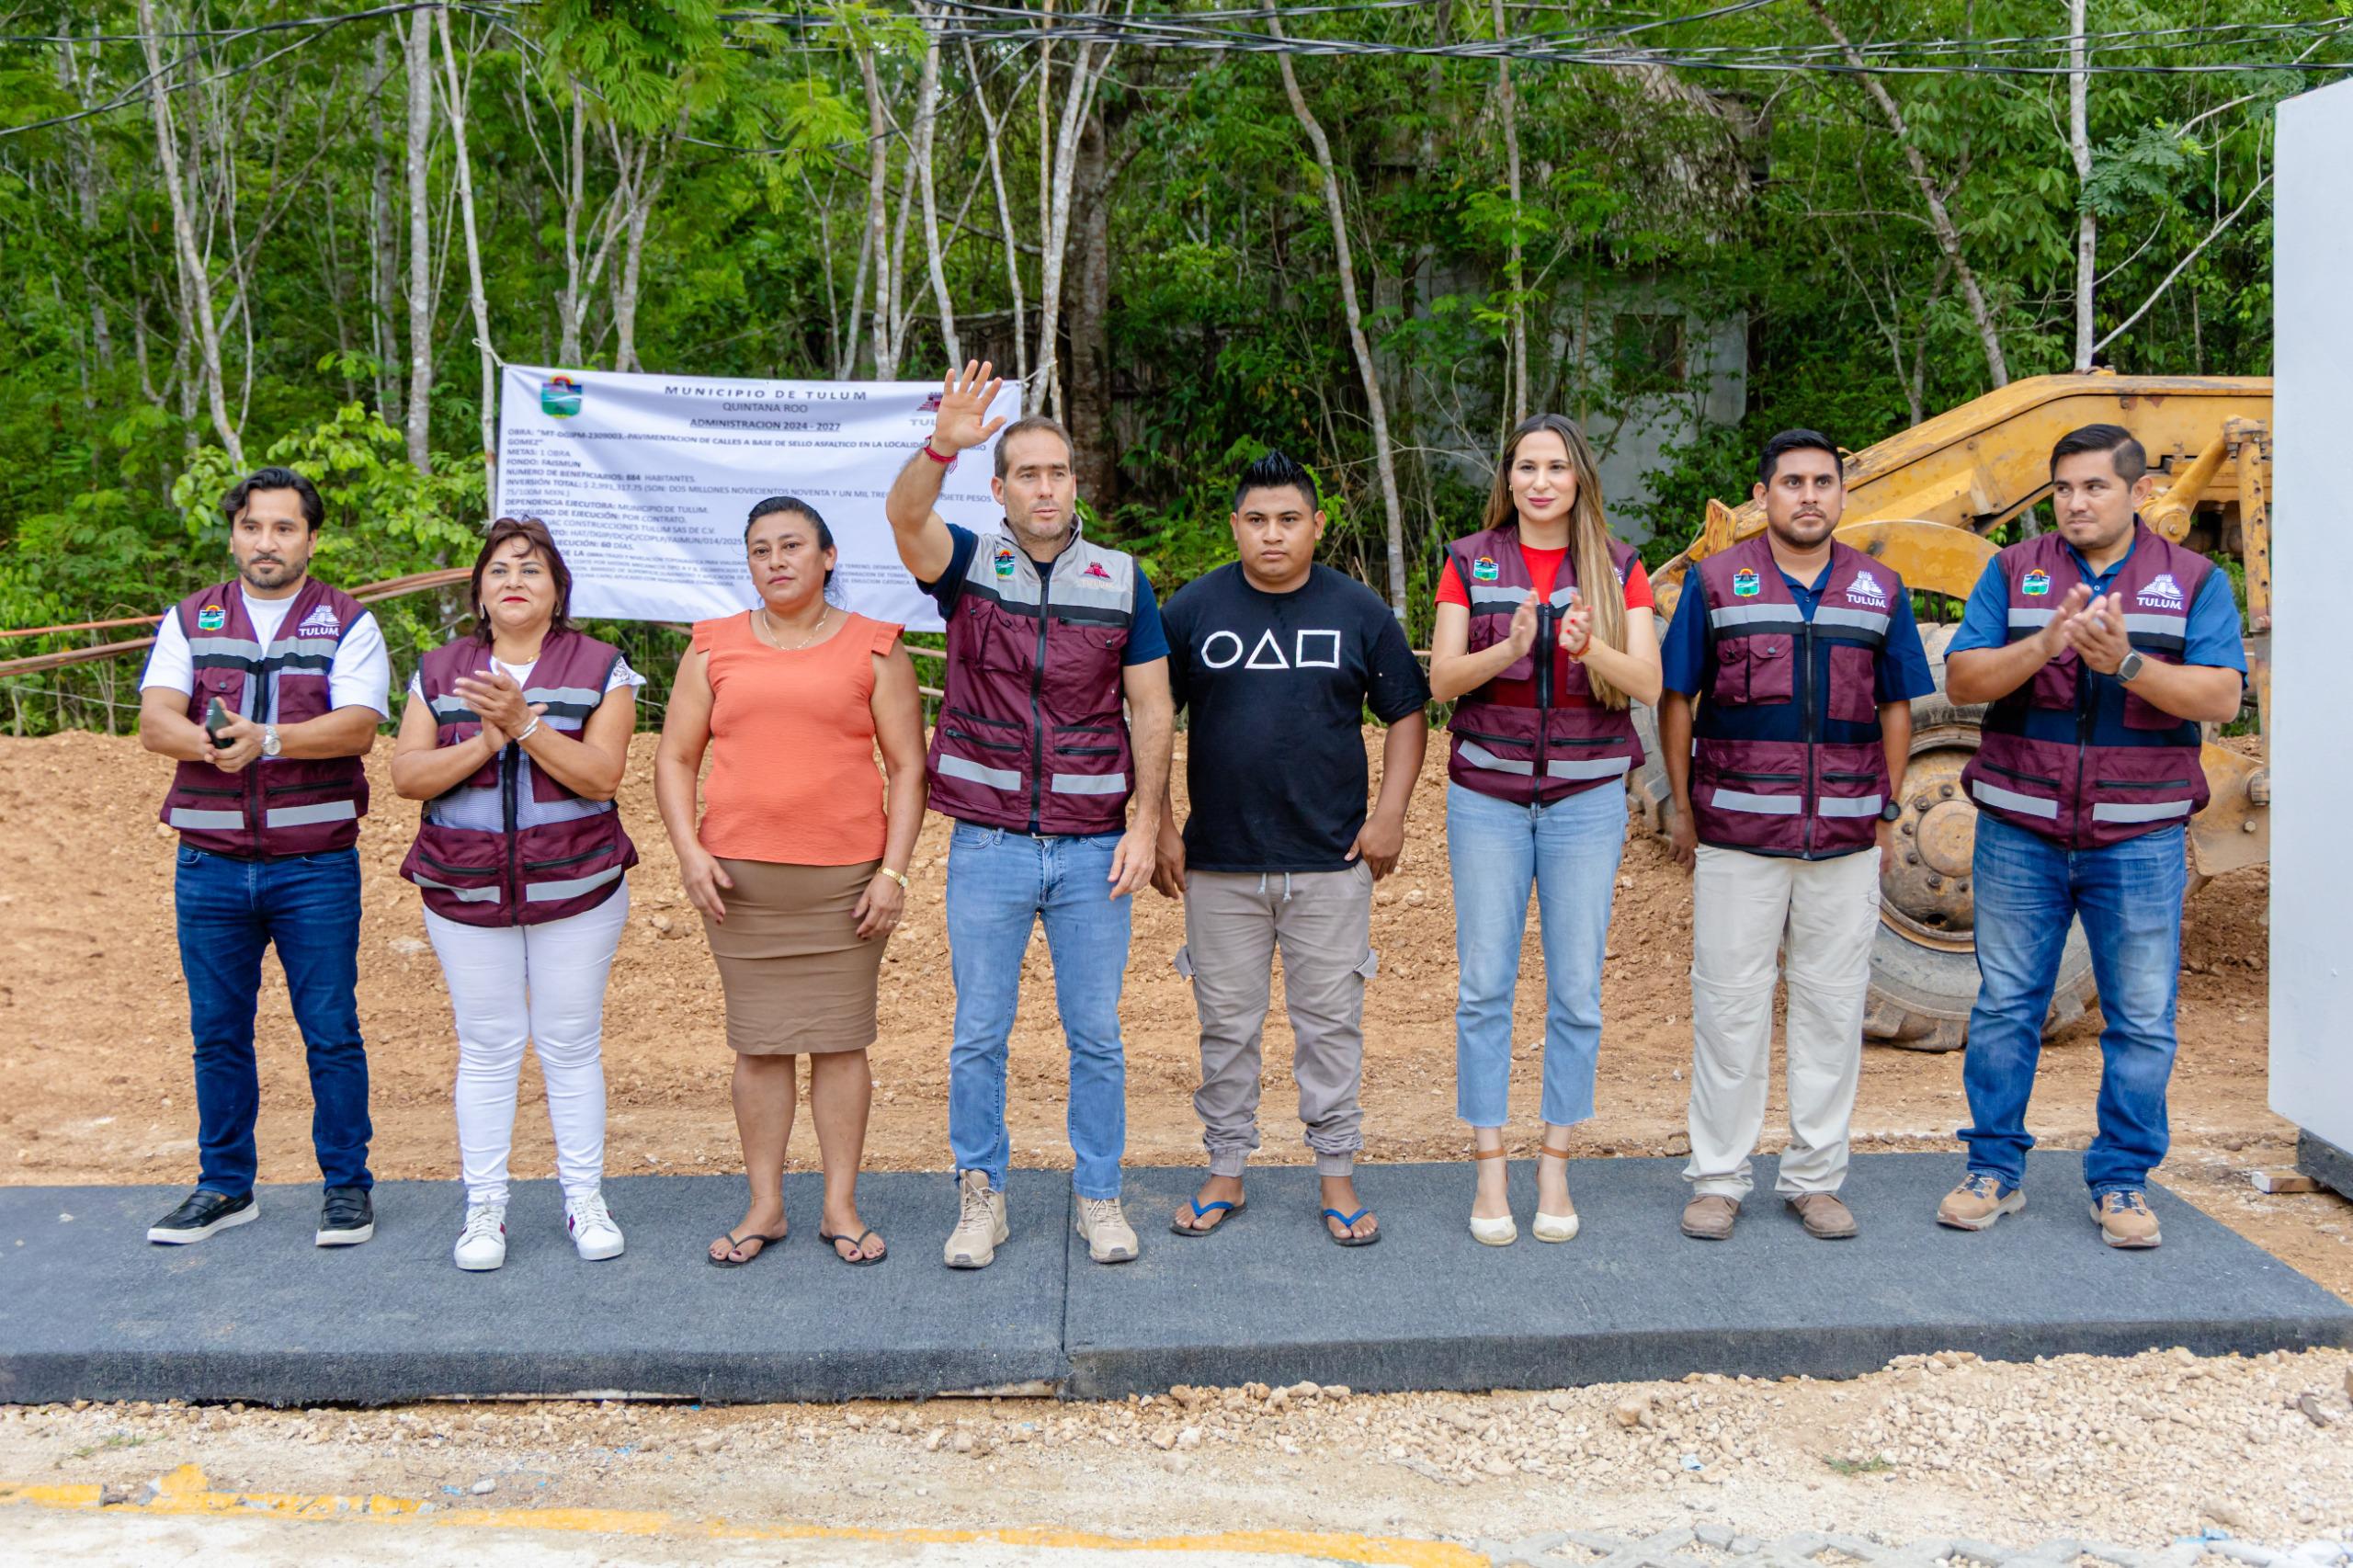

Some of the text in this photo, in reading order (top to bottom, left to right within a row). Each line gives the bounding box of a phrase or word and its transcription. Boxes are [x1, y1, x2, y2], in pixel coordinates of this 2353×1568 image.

[665, 386, 867, 401] MUNICIPIO DE TULUM
[722, 403, 809, 414] QUINTANA ROO
[690, 418, 780, 430] ADMINISTRACION
[783, 420, 808, 430] 2024
[817, 422, 841, 431] 2027
[910, 418, 938, 426] TUL
[789, 439, 813, 448] SELLO
[688, 485, 730, 494] MILLONES
[731, 486, 790, 496] NOVECIENTOS
[791, 489, 831, 497] NOVENTA
[854, 490, 870, 498] MIL
[966, 494, 992, 502] PESOS
[505, 498, 563, 506] DEPENDENCIA
[618, 504, 663, 513] MUNICIPIO
[563, 519, 639, 530] CONSTRUCCIONES
[600, 540, 612, 548] 60
[1846, 594, 1886, 608] TULUM
[2136, 597, 2182, 609] TULUM
[298, 627, 339, 636] TULUM
